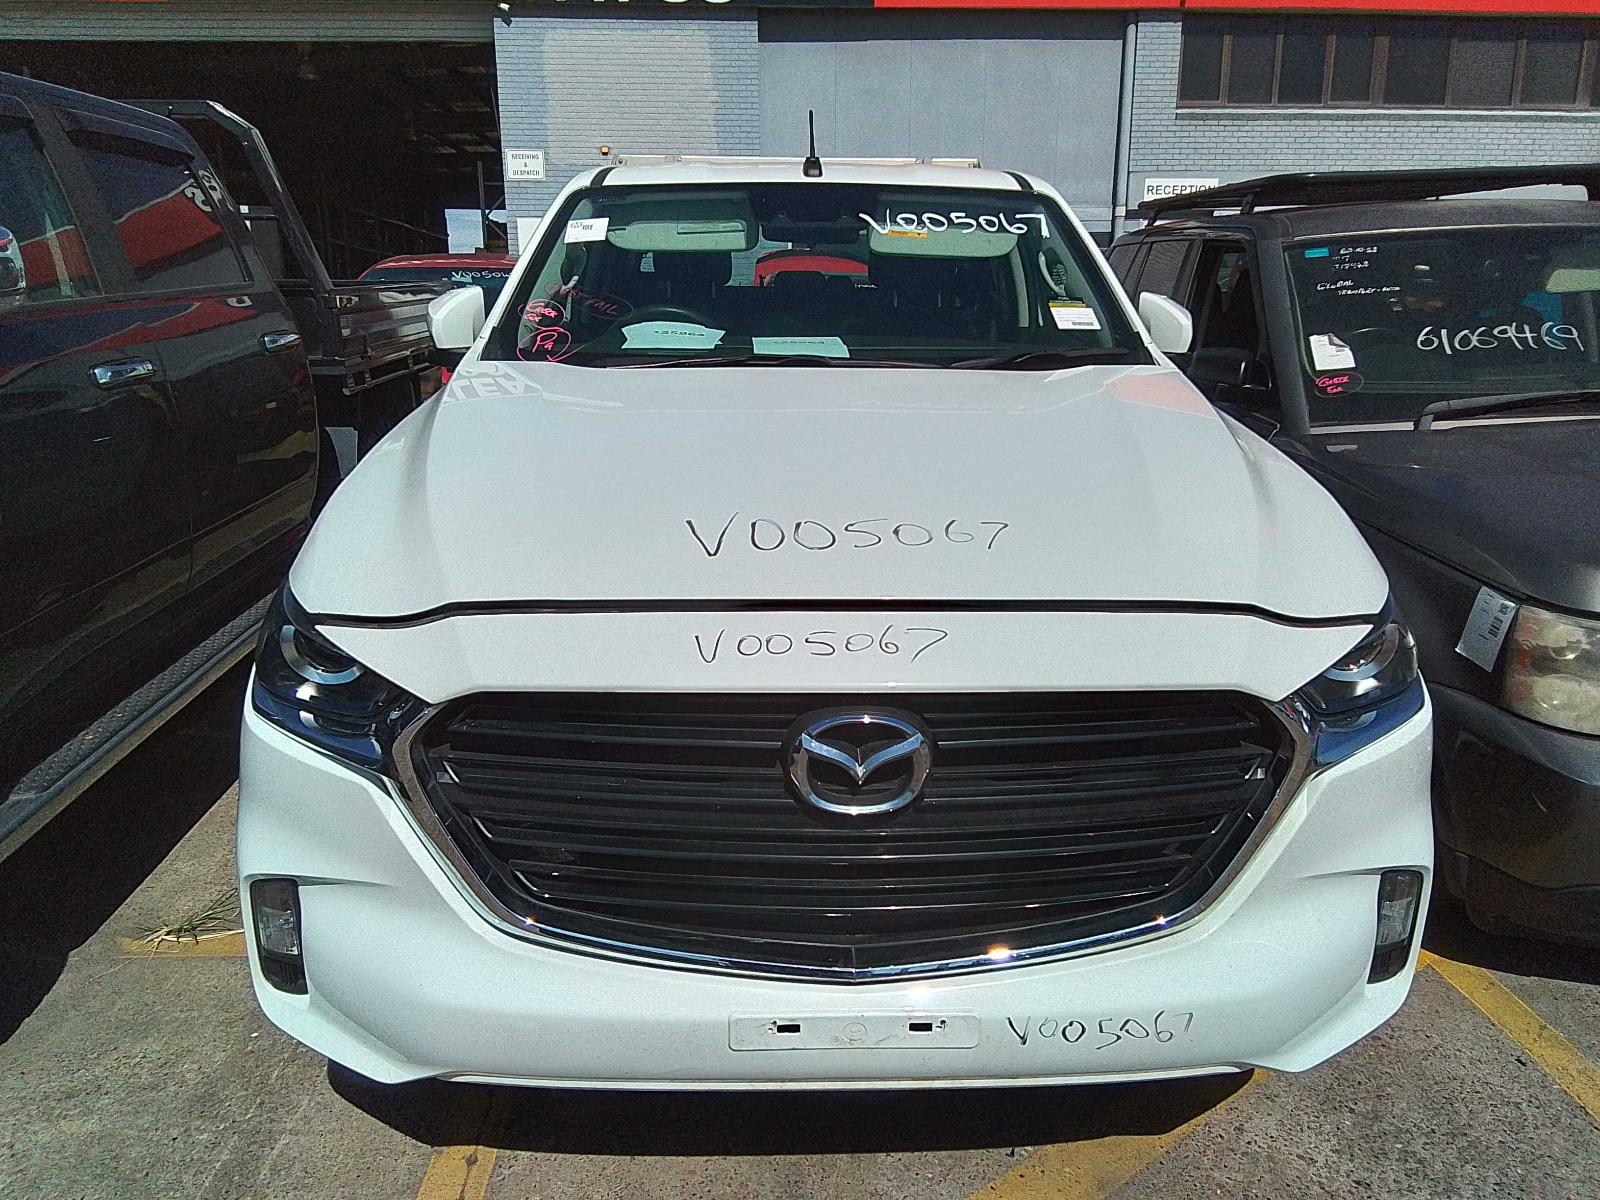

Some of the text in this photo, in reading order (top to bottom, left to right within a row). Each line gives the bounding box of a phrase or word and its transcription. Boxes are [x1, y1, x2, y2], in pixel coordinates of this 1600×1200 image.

[858, 208, 1051, 239] V005067
[1416, 321, 1585, 355] 61069469
[685, 511, 1009, 557] V005067
[694, 624, 949, 664] V005067
[1005, 1010, 1194, 1050] V005067
